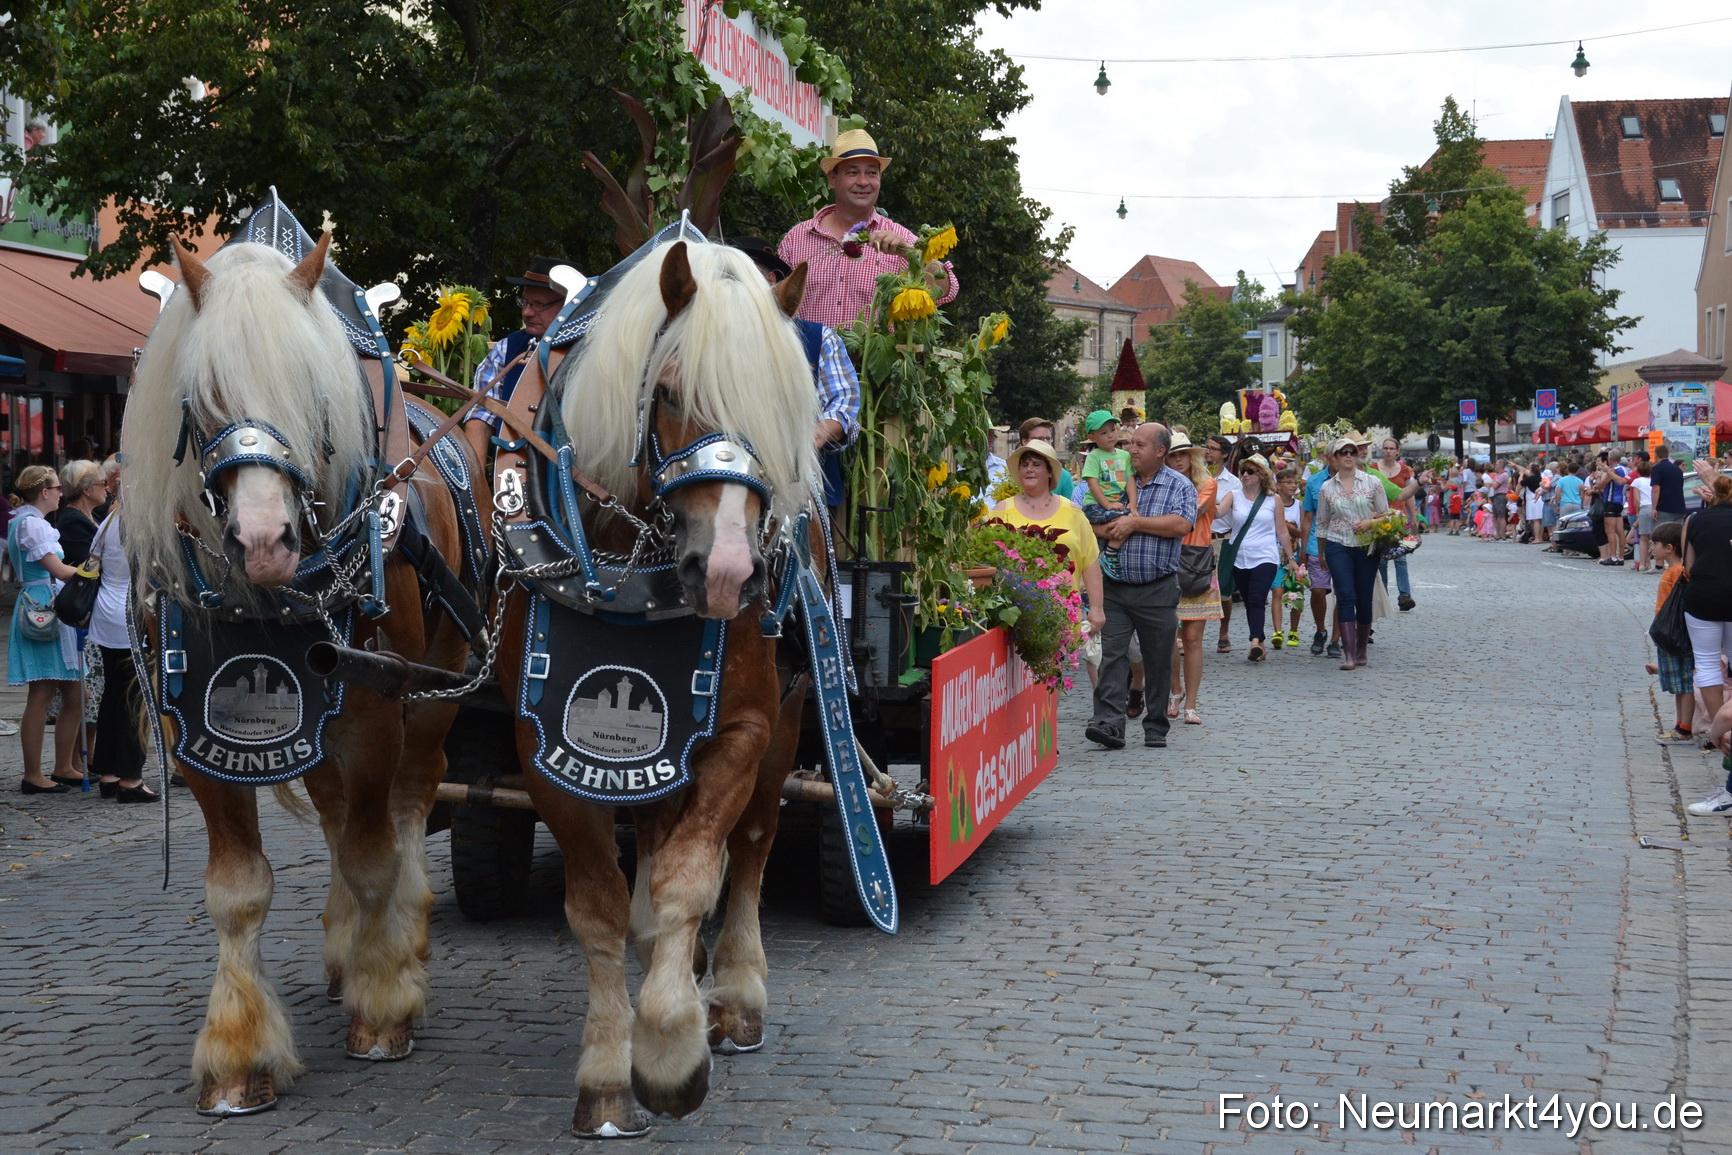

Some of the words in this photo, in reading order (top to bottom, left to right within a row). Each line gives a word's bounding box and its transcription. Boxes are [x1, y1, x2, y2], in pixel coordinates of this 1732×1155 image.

[234, 716, 277, 725] Nürnberg
[276, 723, 288, 732] 247
[577, 736, 621, 754] Wetzendorfer
[636, 743, 648, 752] 247
[592, 731, 637, 744] Nürnberg
[190, 735, 313, 772] LEHNEIS
[545, 746, 676, 790] LEHNEIS
[975, 750, 997, 825] des
[998, 745, 1019, 802] san
[1019, 703, 1037, 781] mir!
